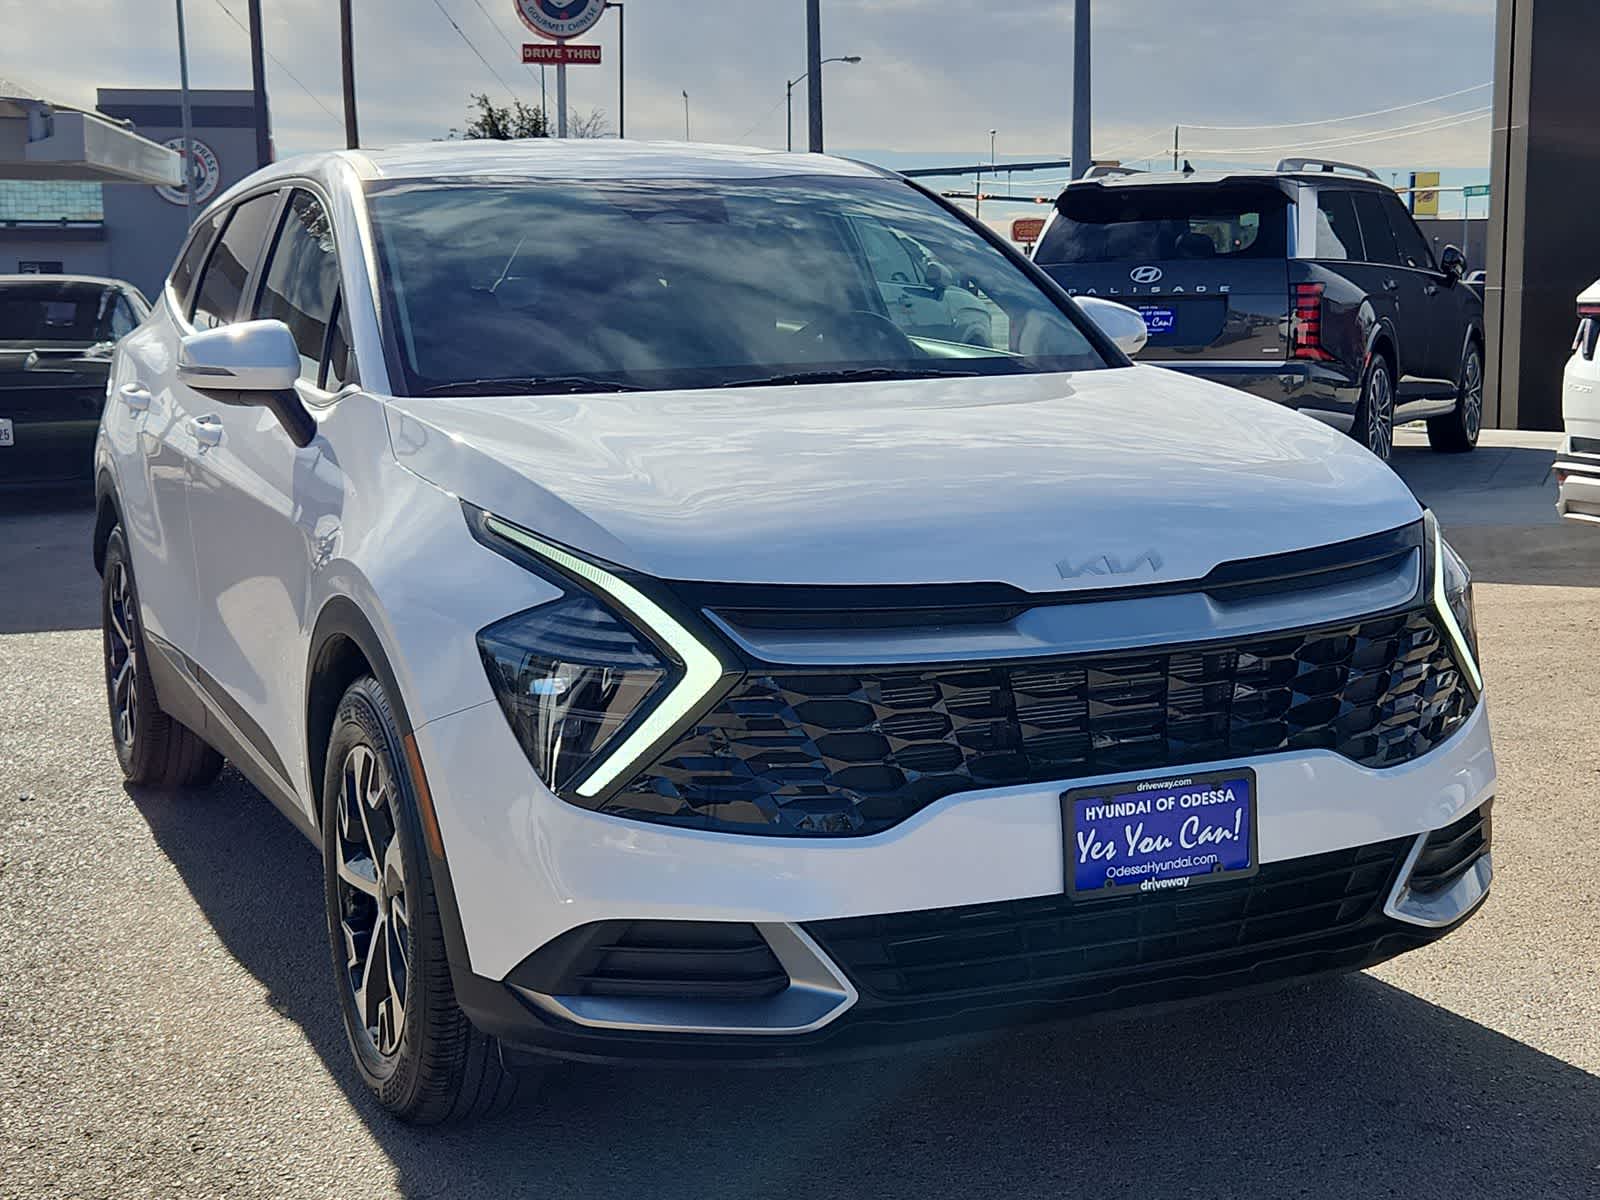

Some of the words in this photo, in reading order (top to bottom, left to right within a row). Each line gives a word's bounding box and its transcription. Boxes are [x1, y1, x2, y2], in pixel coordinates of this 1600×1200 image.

[527, 6, 565, 32] GOURMET
[524, 48, 562, 58] DRIVE
[566, 49, 600, 59] THRU
[1068, 285, 1230, 295] PALISADE
[1055, 550, 1164, 580] KIA
[1136, 777, 1192, 793] driveway.com
[1085, 800, 1151, 822] HYUNDAI
[1155, 796, 1176, 812] OF
[1180, 788, 1236, 809] ODESSA
[1076, 828, 1117, 864] Yes
[1124, 822, 1173, 857] You
[1179, 807, 1243, 850] Can!
[1106, 853, 1218, 879] OdessaHyundai.com
[1140, 876, 1190, 892] driveway
